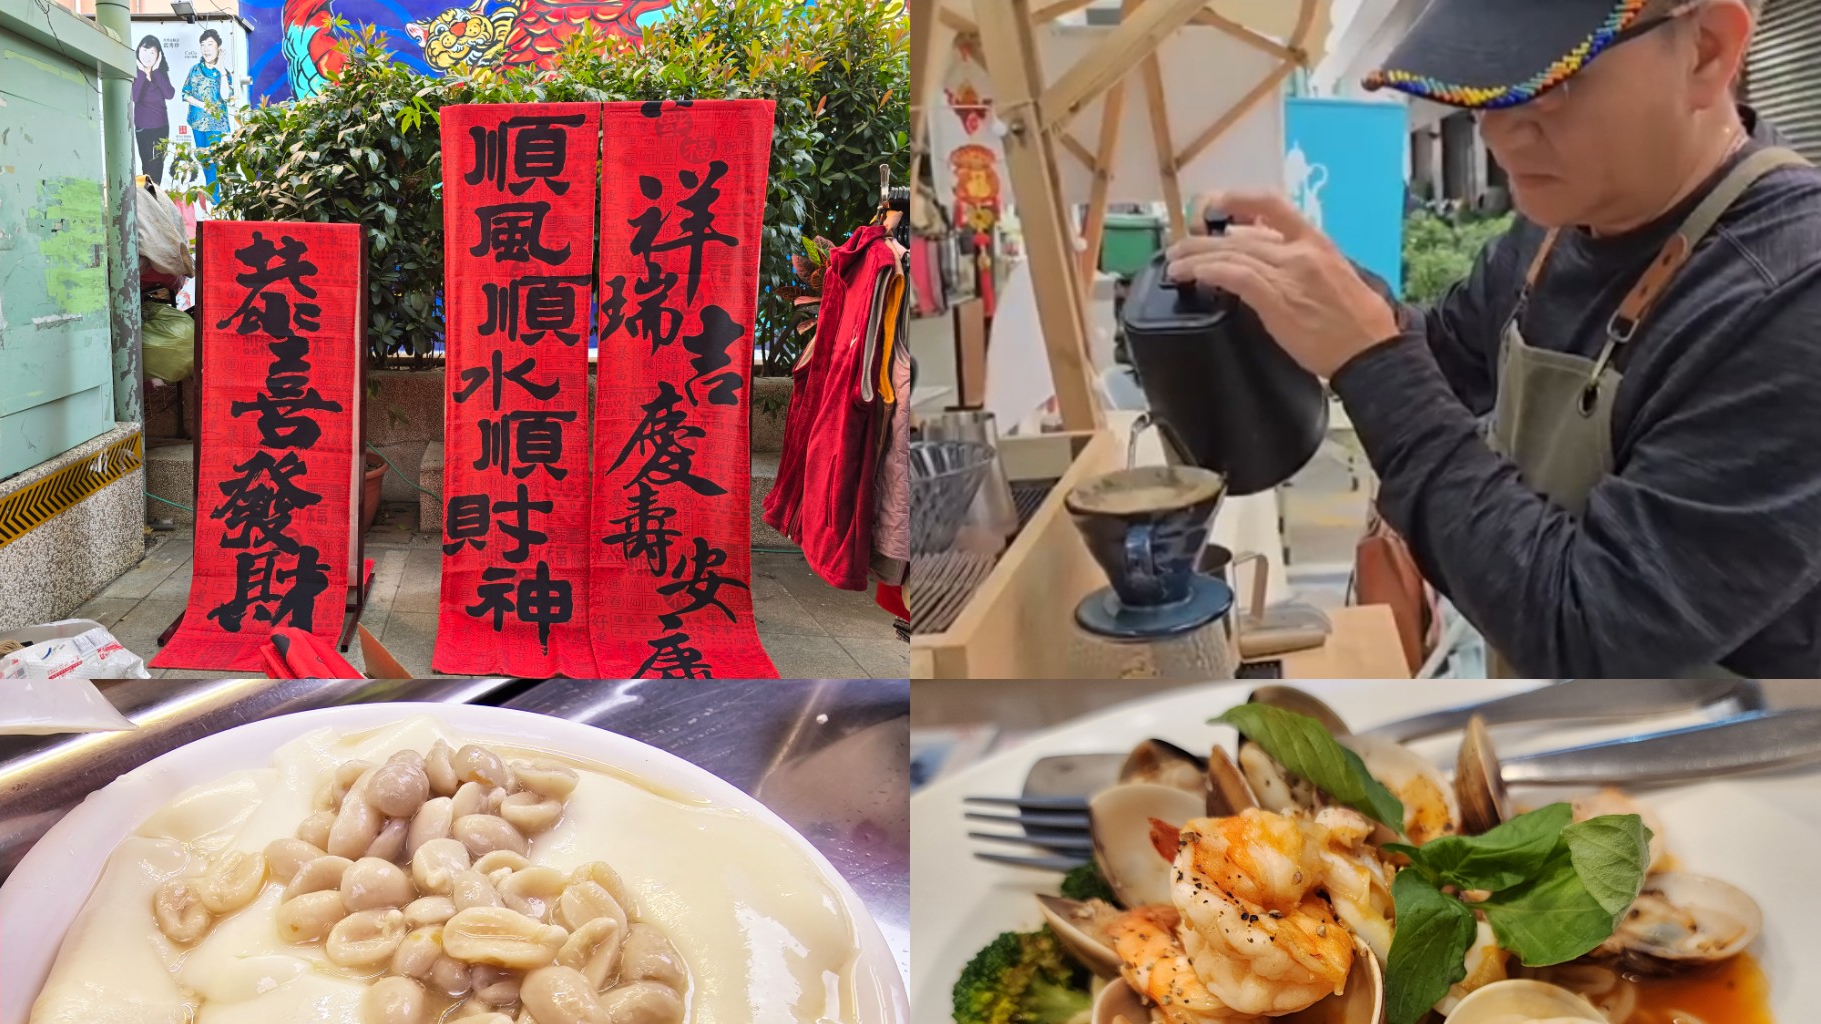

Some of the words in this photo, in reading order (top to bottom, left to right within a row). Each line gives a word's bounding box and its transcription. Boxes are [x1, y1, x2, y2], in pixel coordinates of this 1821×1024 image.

[207, 230, 344, 633] 恭喜發財
[442, 114, 592, 656] 順風順水順財神
